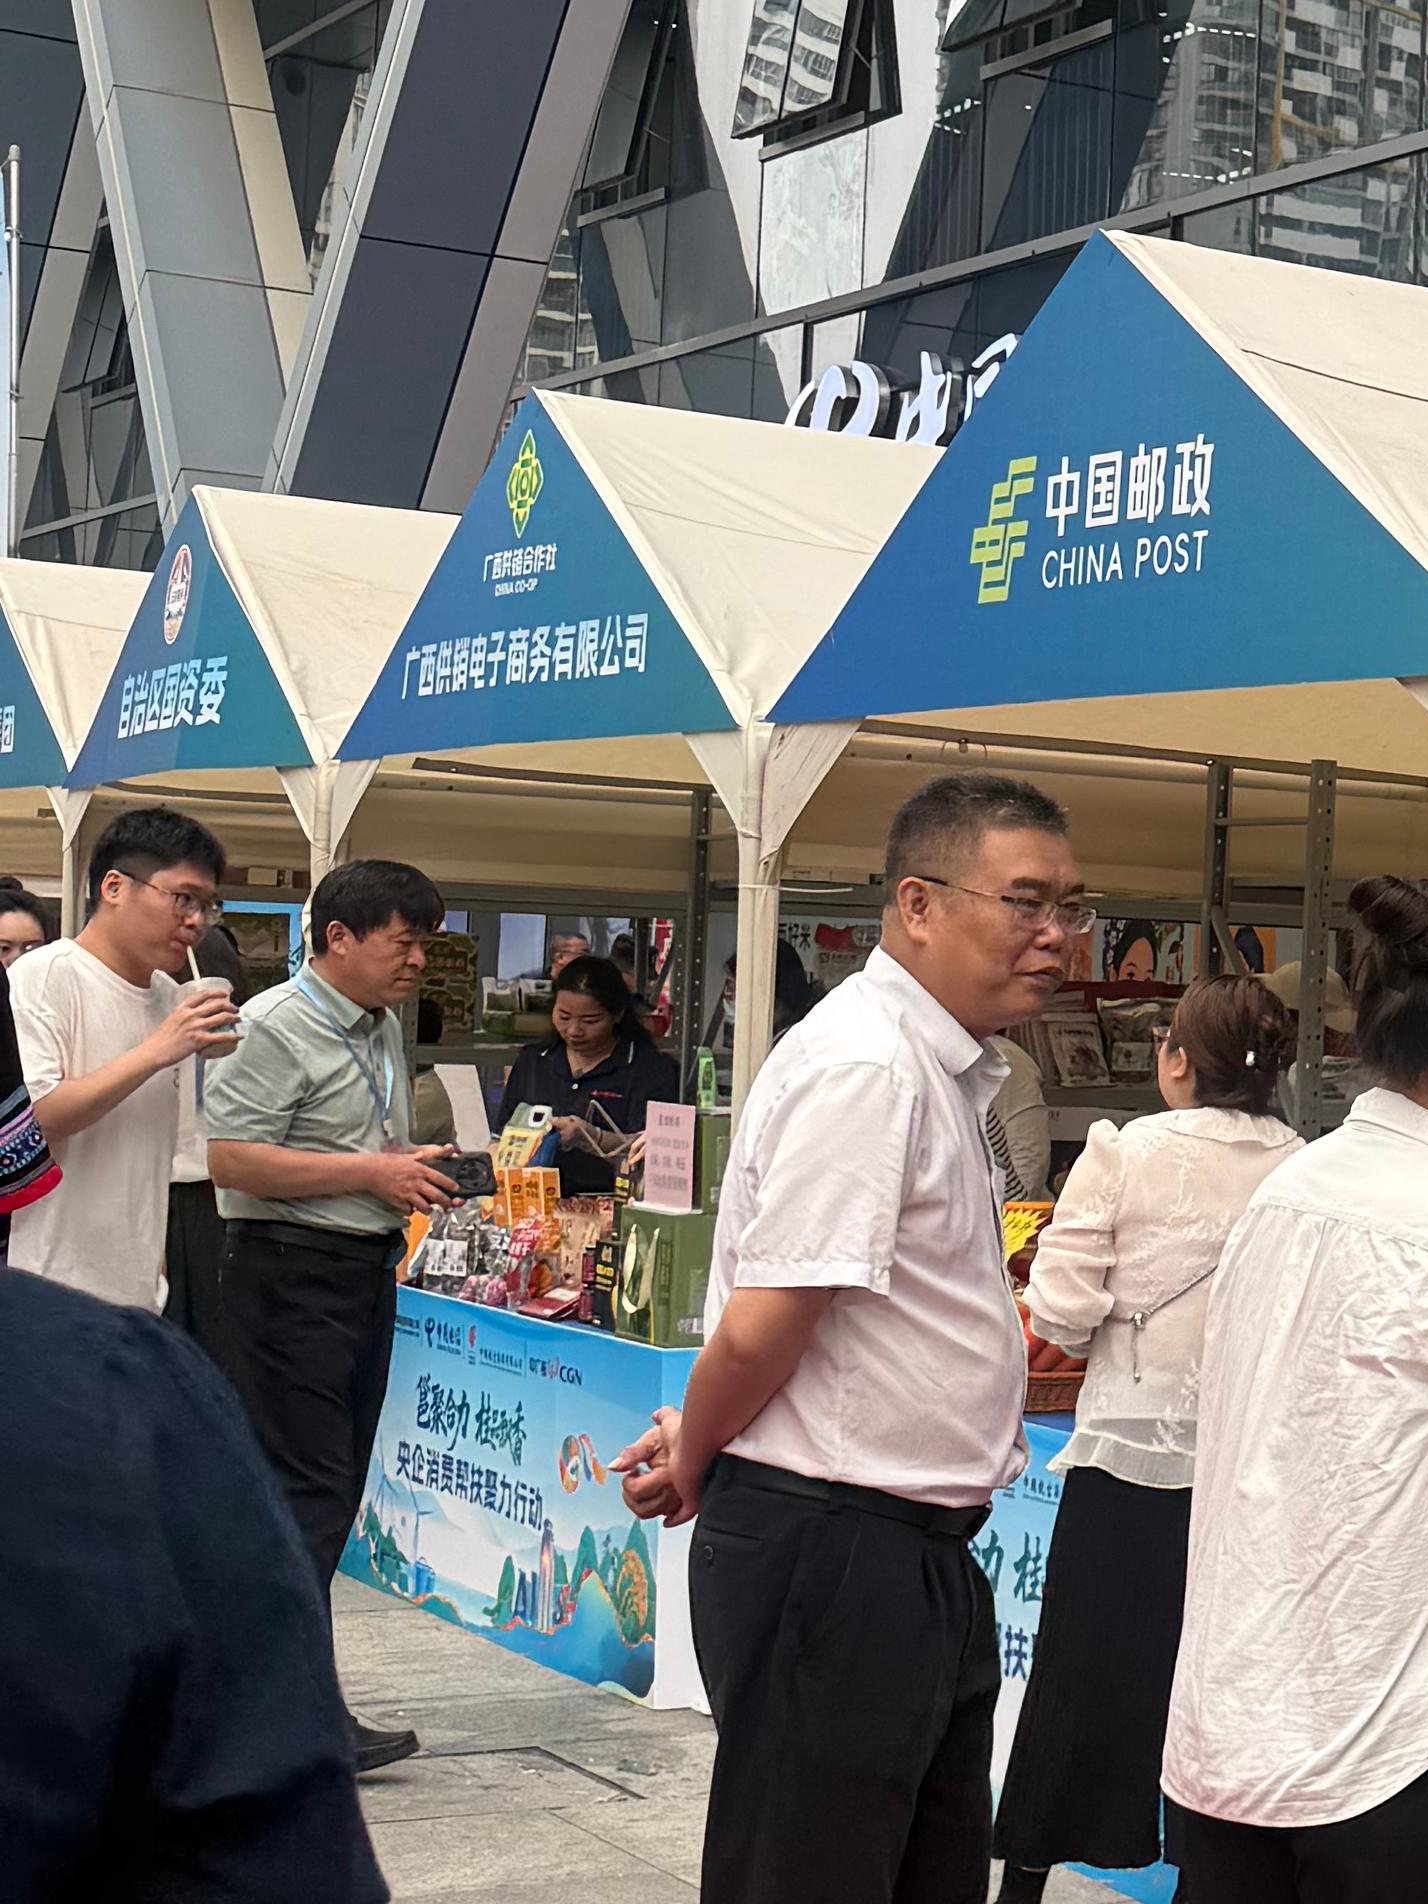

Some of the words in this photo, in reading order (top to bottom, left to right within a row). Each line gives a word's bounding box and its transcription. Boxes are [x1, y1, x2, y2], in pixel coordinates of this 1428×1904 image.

[1046, 433, 1214, 537] 中国邮政
[483, 544, 557, 582] 广西供销合作社
[1042, 542, 1123, 589] CHINA
[1135, 530, 1209, 580] POST
[117, 656, 228, 739] 自治区国资委
[402, 613, 648, 700] 广西供销电子商务有限公司
[559, 1364, 583, 1387] CGN
[396, 1440, 544, 1531] 央企消费帮扶聚力行动
